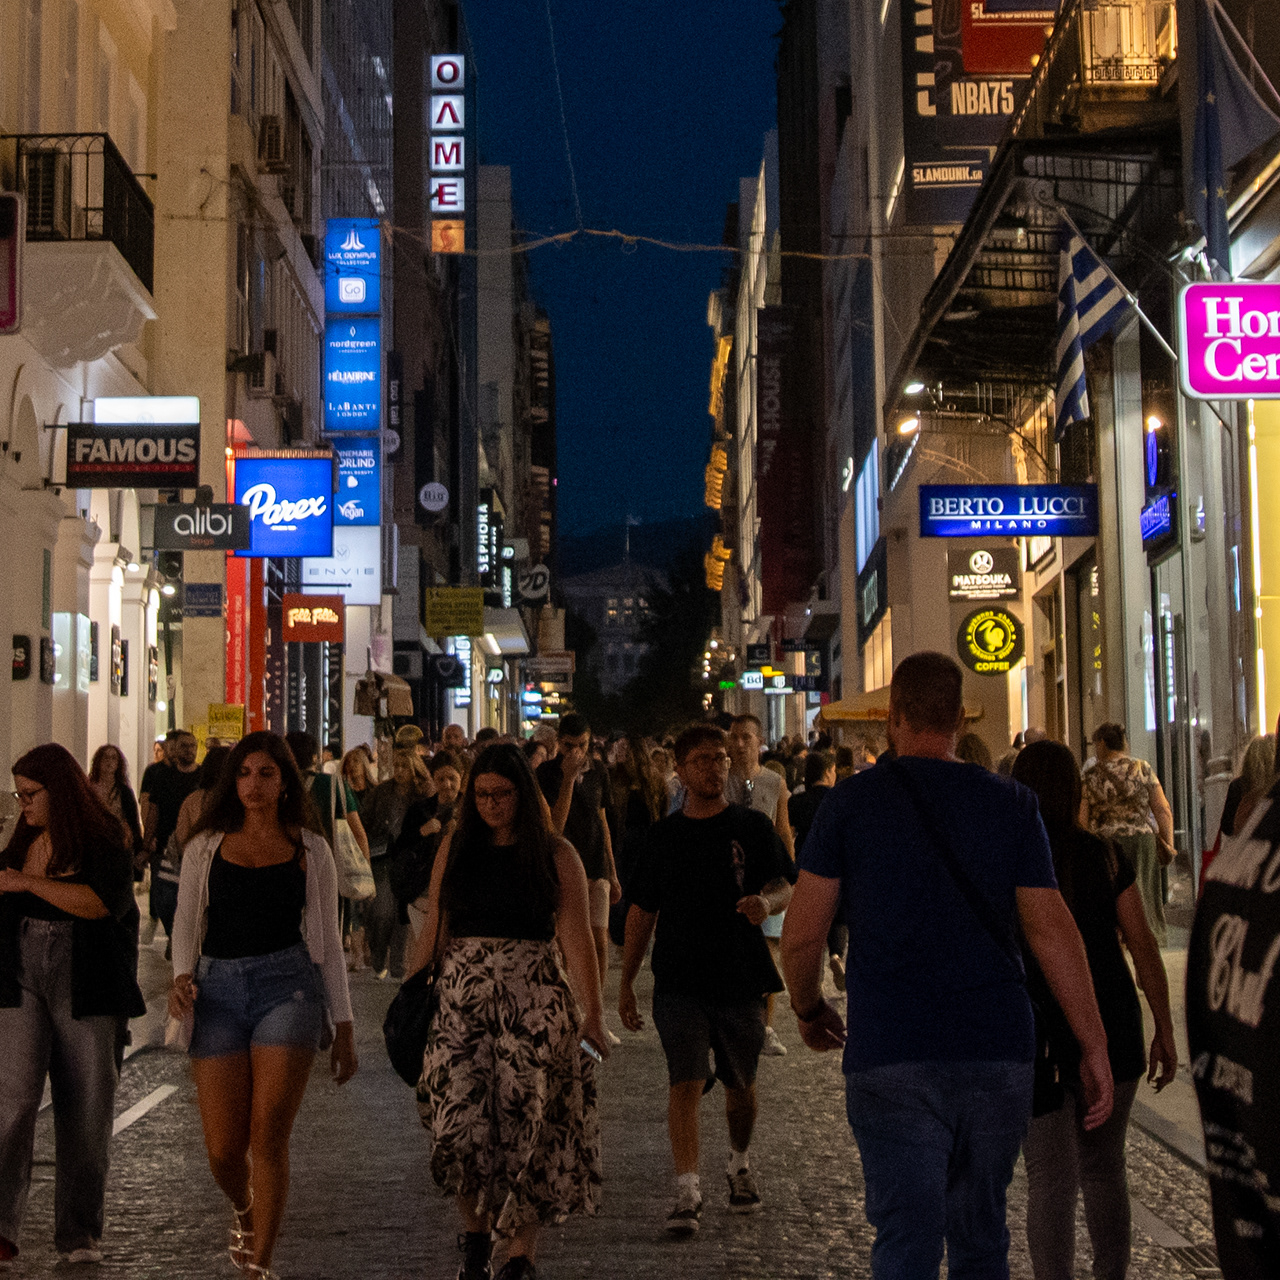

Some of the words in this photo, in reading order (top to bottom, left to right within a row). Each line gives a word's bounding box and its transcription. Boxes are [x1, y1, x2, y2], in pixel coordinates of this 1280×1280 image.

[951, 82, 1014, 116] NBA75
[913, 166, 983, 183] SLAMDUNK.GR
[329, 340, 377, 349] nordgreen
[75, 438, 196, 463] FAMOUS
[339, 458, 375, 468] ORLIND
[241, 483, 327, 525] Parex
[338, 500, 364, 520] Vegan
[930, 497, 1004, 515] BERTO
[1019, 497, 1085, 514] LUCCI
[173, 507, 233, 536] alibi
[971, 520, 1047, 529] MILANO
[478, 503, 490, 573] SEPHORA
[309, 567, 375, 576] ENVIE
[953, 573, 1012, 587] MATSOUKA
[975, 661, 1009, 671] COFFEE
[747, 675, 762, 684] Bd
